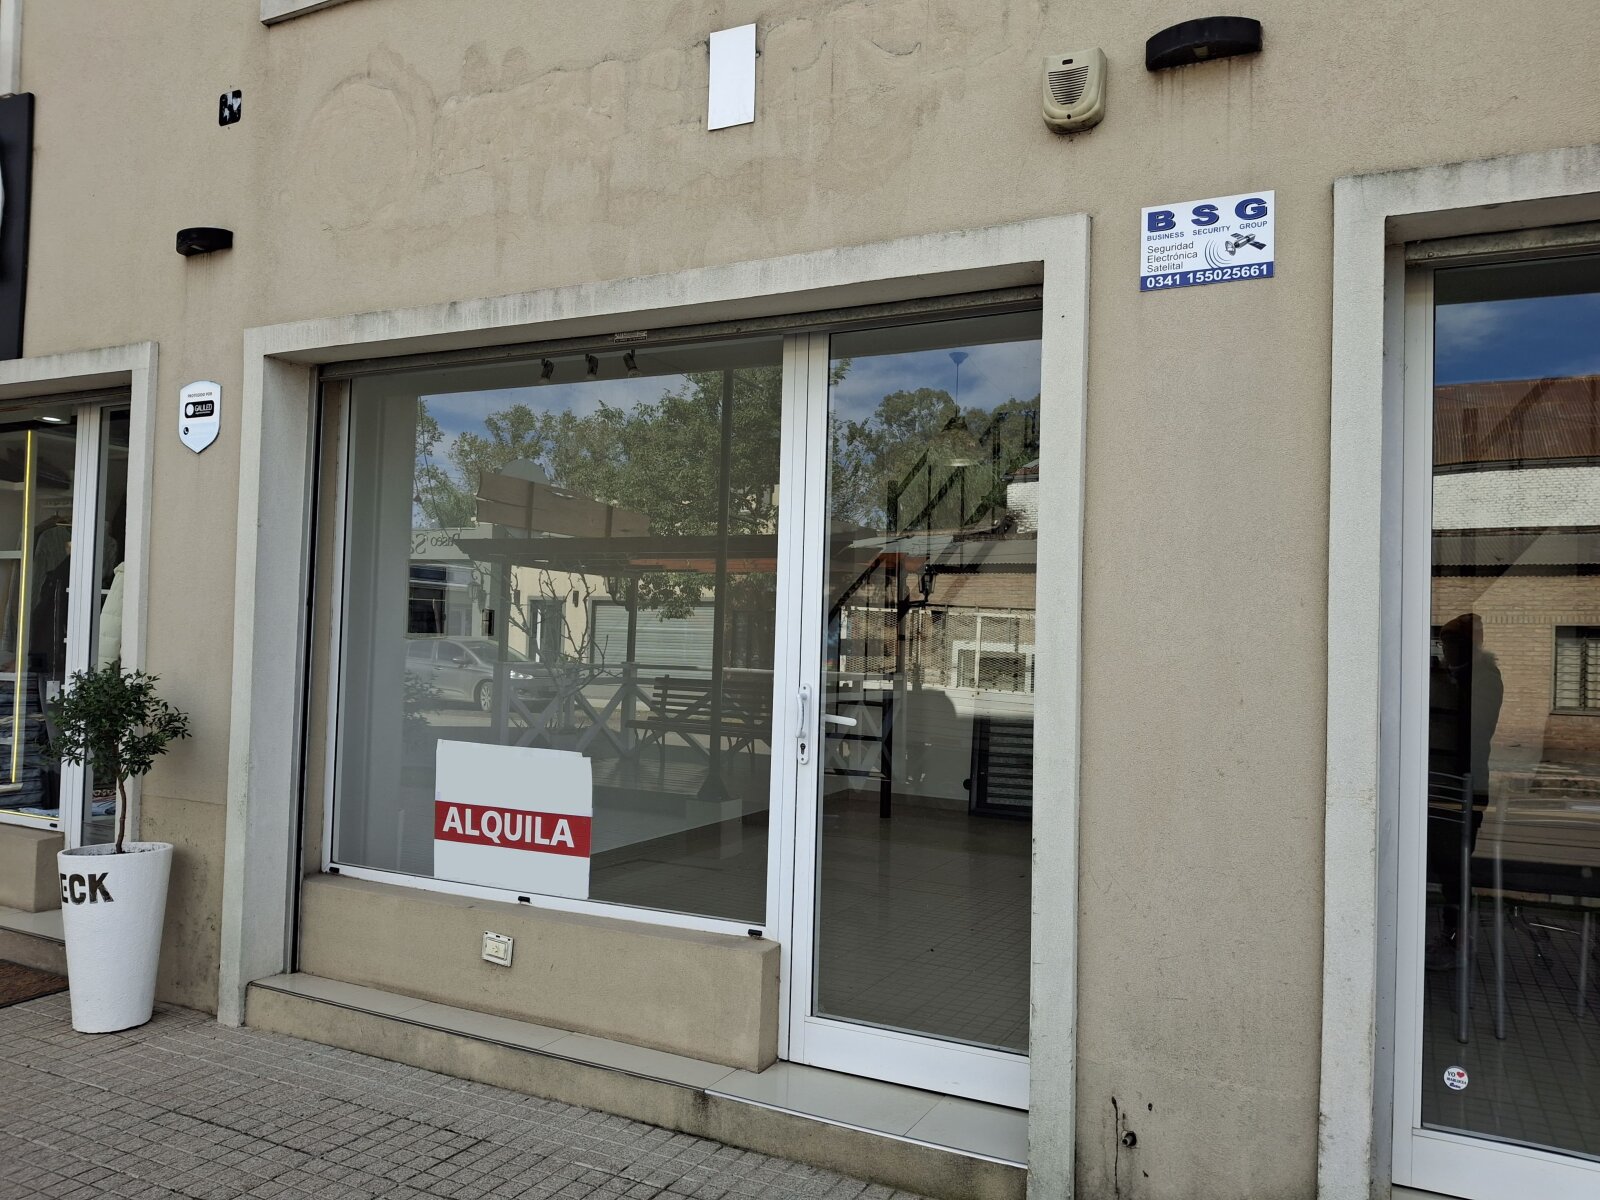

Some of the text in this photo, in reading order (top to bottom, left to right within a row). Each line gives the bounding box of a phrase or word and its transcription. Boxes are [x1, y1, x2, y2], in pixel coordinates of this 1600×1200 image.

[1148, 197, 1268, 233] B S G
[1146, 220, 1268, 242] BUSINESS SECURITY GROUP
[1147, 241, 1194, 255] Seguridad
[1147, 250, 1198, 264] Electrónica
[1146, 261, 1184, 273] Satelital
[1146, 264, 1268, 288] 0341 155025661
[442, 806, 575, 848] ALQUILA
